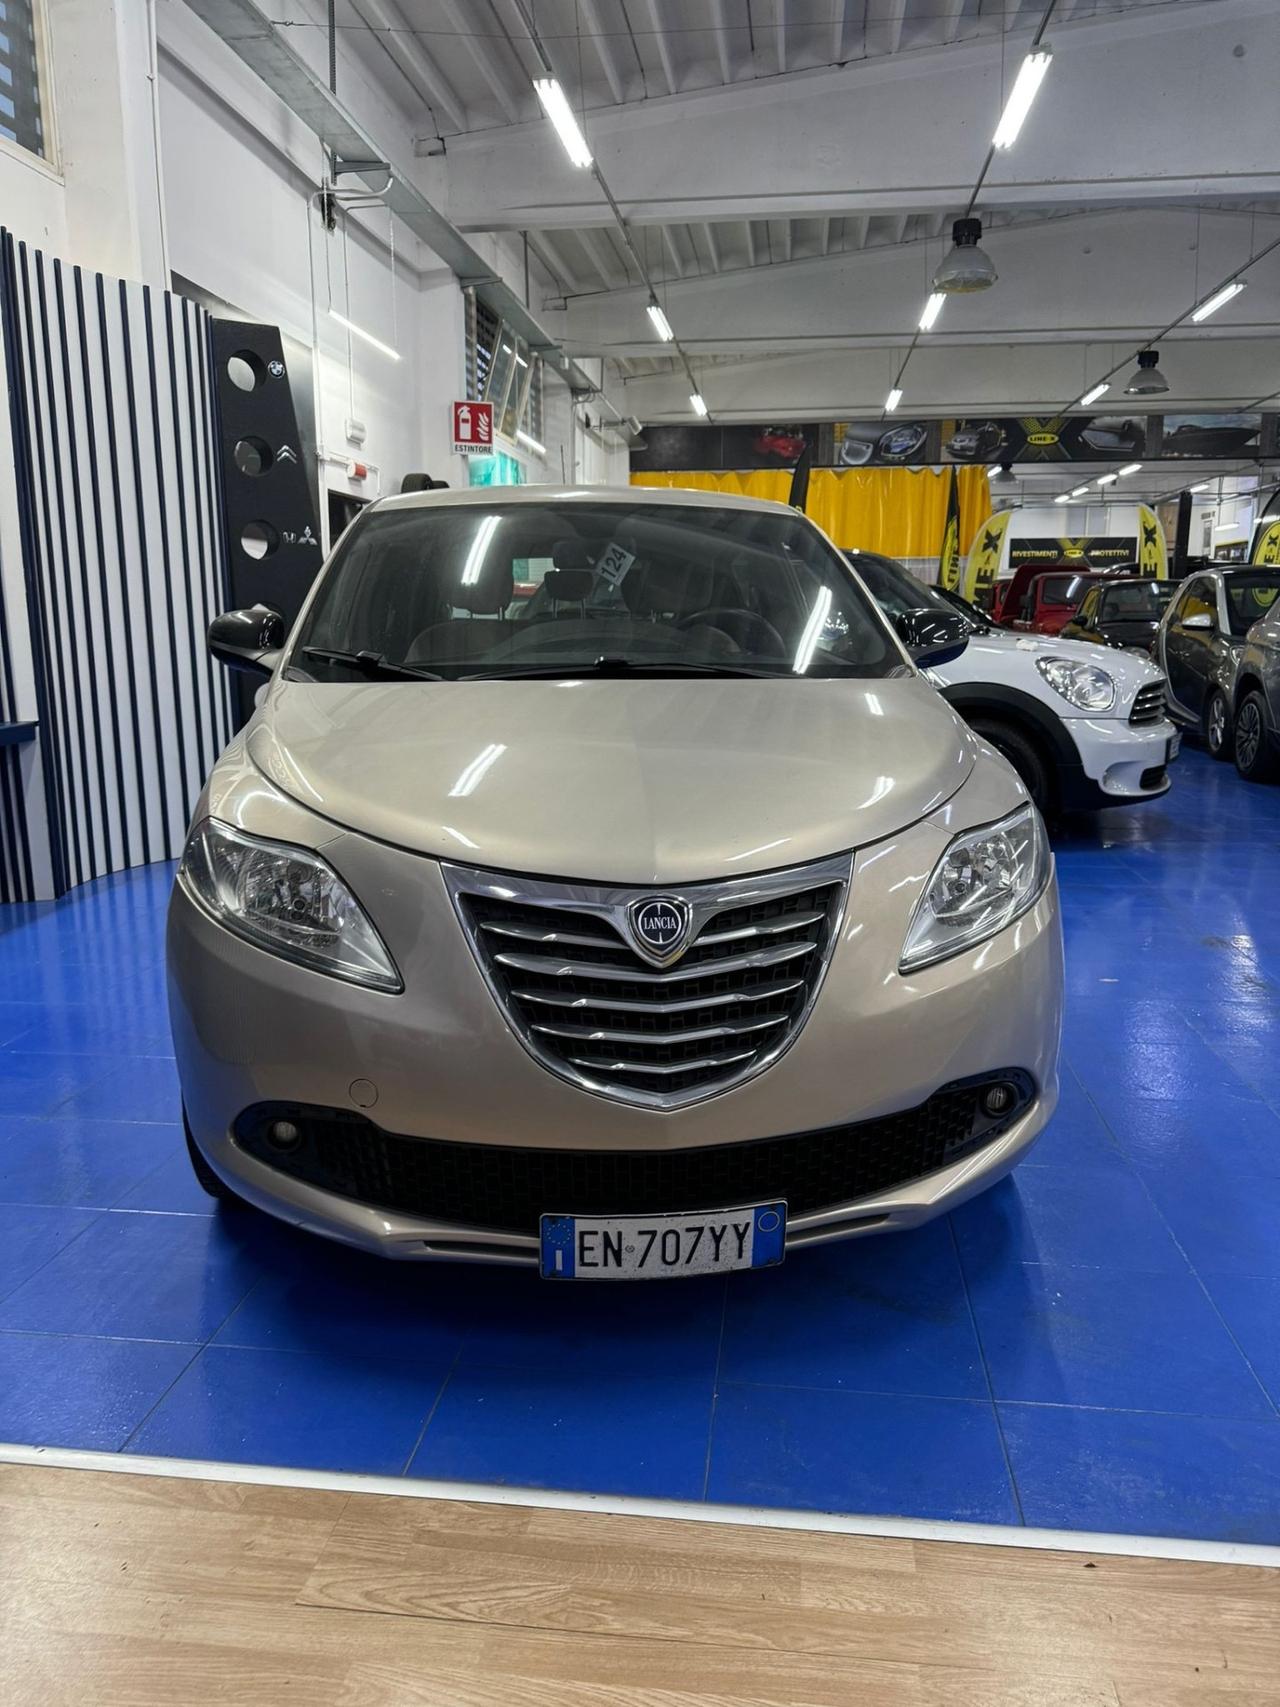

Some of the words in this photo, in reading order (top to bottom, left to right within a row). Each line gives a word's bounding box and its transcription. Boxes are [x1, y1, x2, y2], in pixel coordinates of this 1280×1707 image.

[455, 444, 492, 453] ESTINTORE
[1012, 550, 1058, 558] RIVESTIMENTI
[1088, 549, 1129, 557] PROTETTIVI
[1142, 523, 1157, 579] E-X
[601, 548, 627, 577] 124
[643, 916, 677, 930] LANCIA
[578, 1230, 623, 1268] EN
[637, 1221, 751, 1268] 707YY
